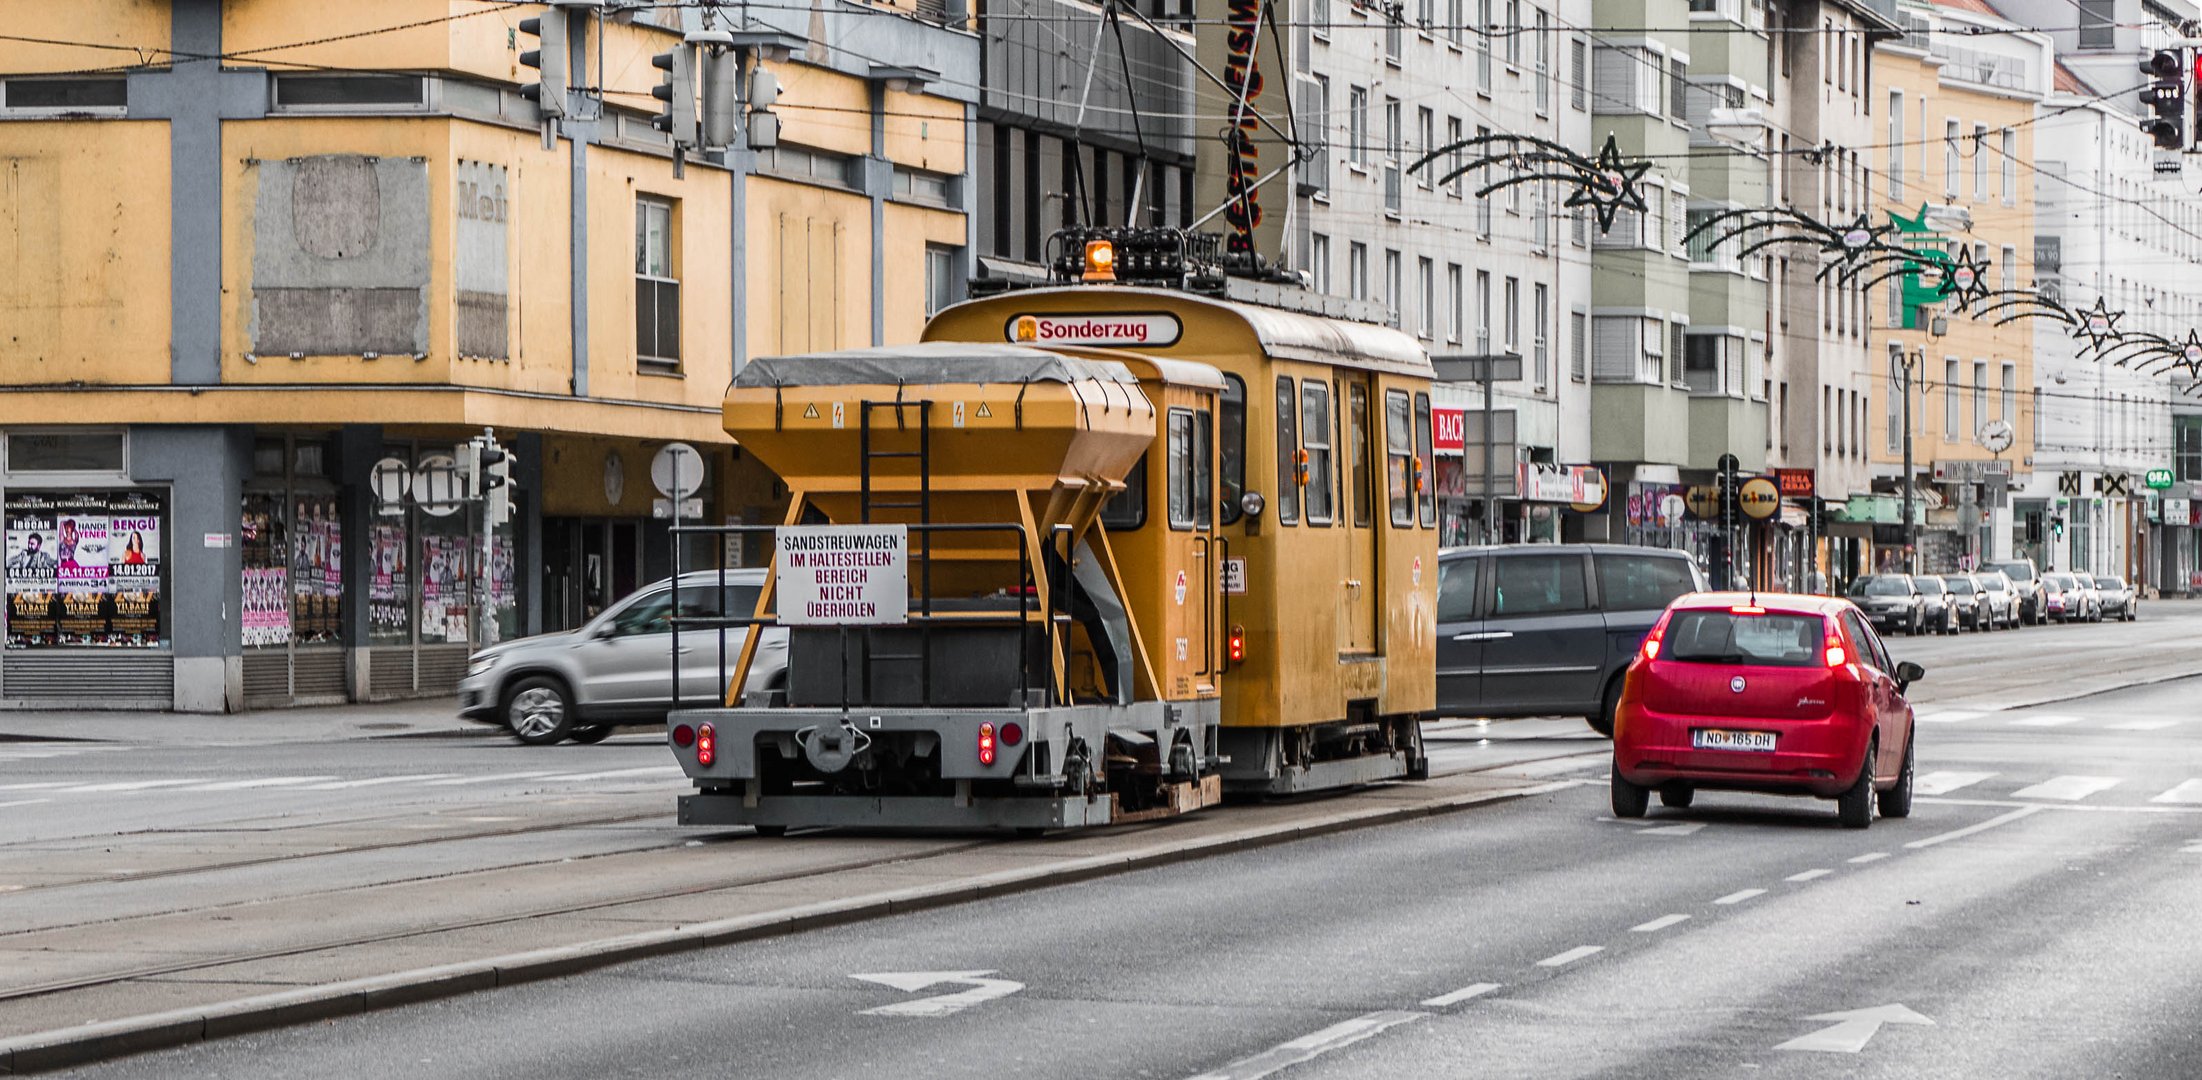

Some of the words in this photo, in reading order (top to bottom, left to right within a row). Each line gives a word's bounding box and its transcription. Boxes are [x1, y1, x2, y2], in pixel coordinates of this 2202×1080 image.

[1039, 320, 1148, 342] Sonderzug
[113, 516, 156, 531] BENGÜ
[79, 530, 107, 539] YENER
[784, 534, 898, 551] SANDSTREUWAGEN
[790, 552, 806, 567] IM
[809, 551, 896, 567] HALTESTELLEN-
[9, 567, 54, 578] 04.02.2017
[112, 564, 156, 576] 14.01.2017
[815, 569, 868, 584] BEREICH
[819, 586, 864, 601] NICHT
[806, 601, 876, 617] ÜBERHOLEN
[1706, 731, 1722, 744] ND
[1732, 733, 1752, 746] 165
[1754, 734, 1770, 747] DH
